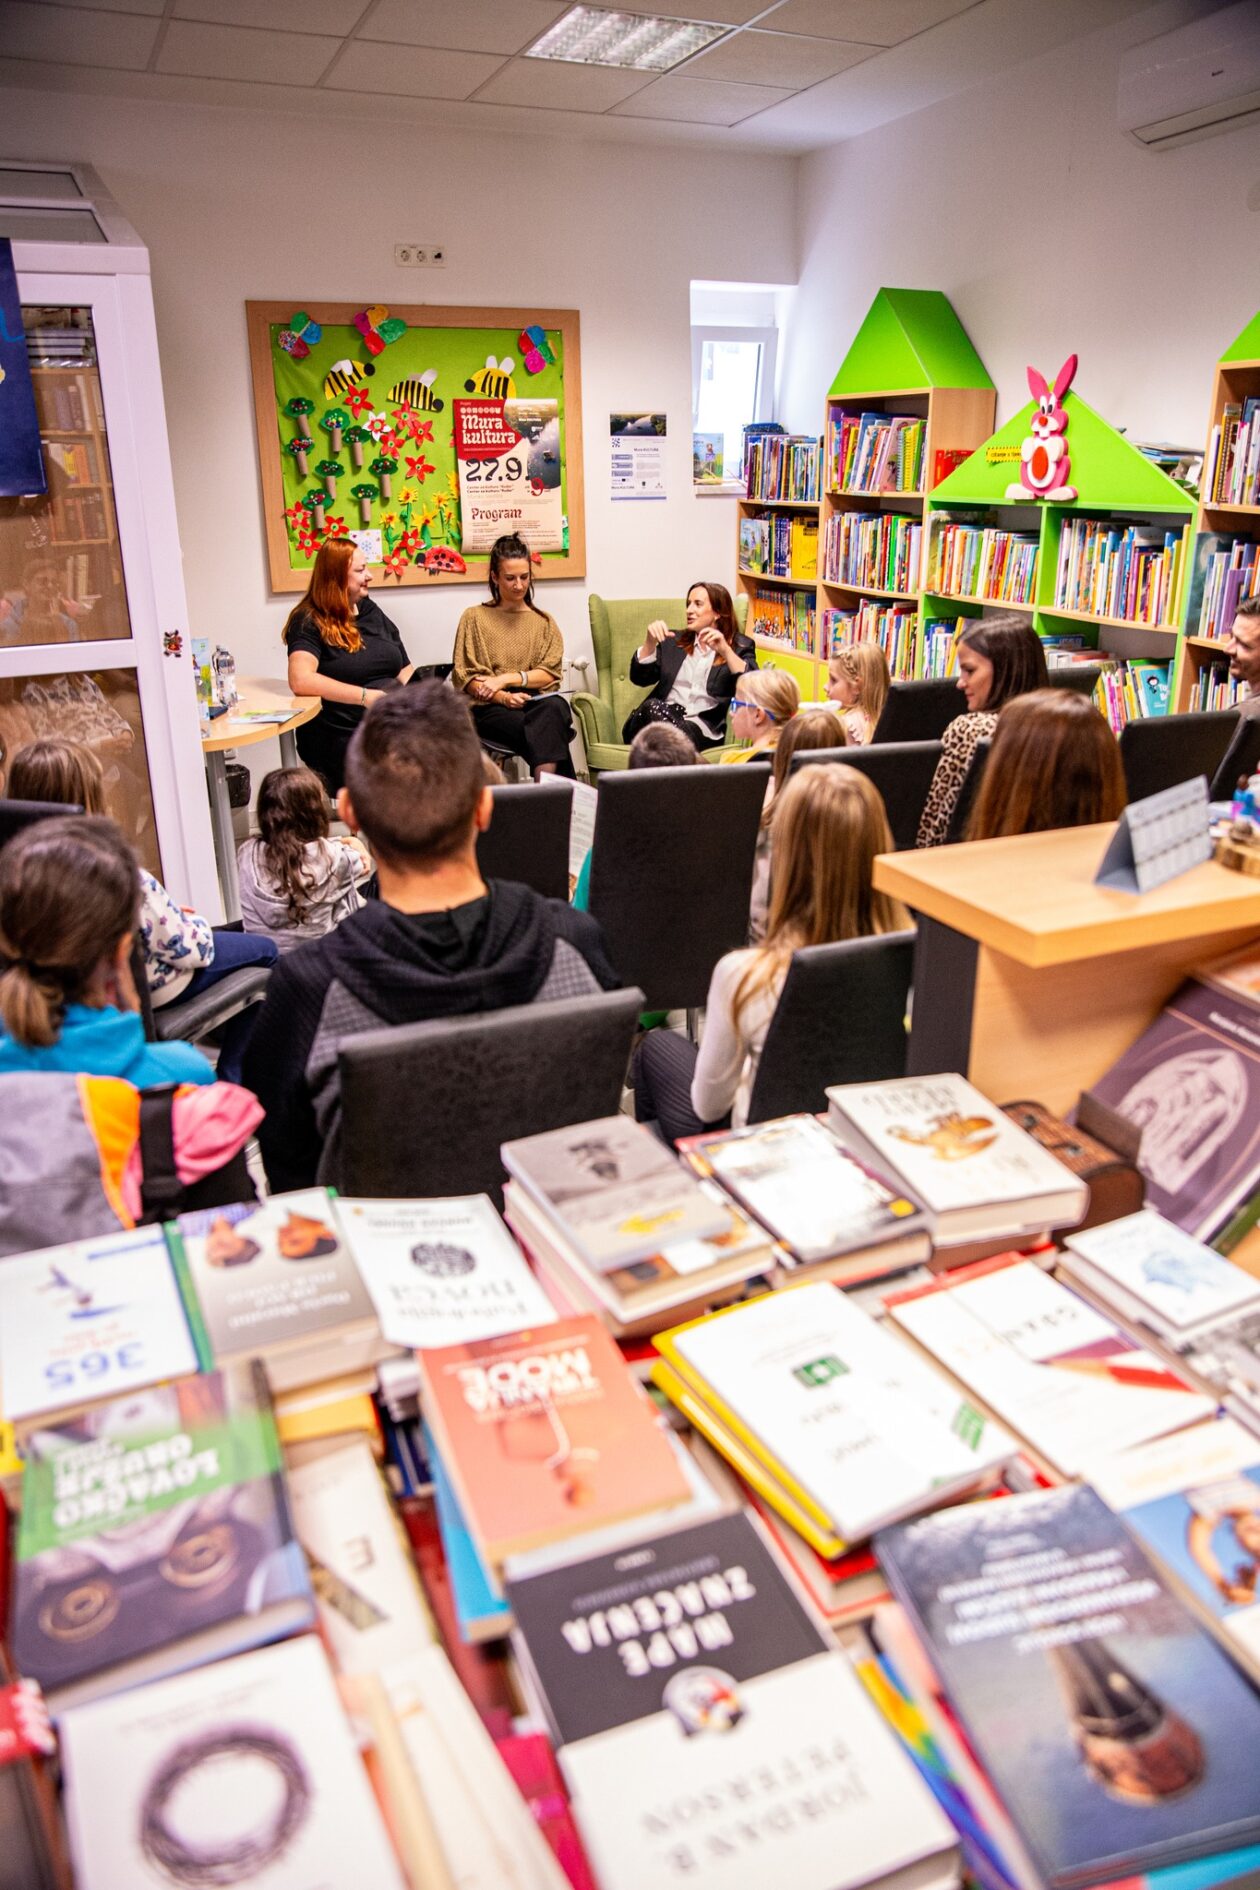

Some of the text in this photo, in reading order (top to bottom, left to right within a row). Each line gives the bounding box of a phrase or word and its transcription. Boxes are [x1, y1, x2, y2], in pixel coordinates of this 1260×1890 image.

[461, 414, 503, 430] Mura
[462, 429, 516, 444] kultura
[471, 508, 522, 522] Program
[43, 1341, 147, 1393] 365
[457, 1345, 592, 1397] MODE
[617, 1611, 735, 1678] MAPE
[640, 1739, 853, 1840] PETERSON
[704, 1767, 874, 1859] JORDAN
